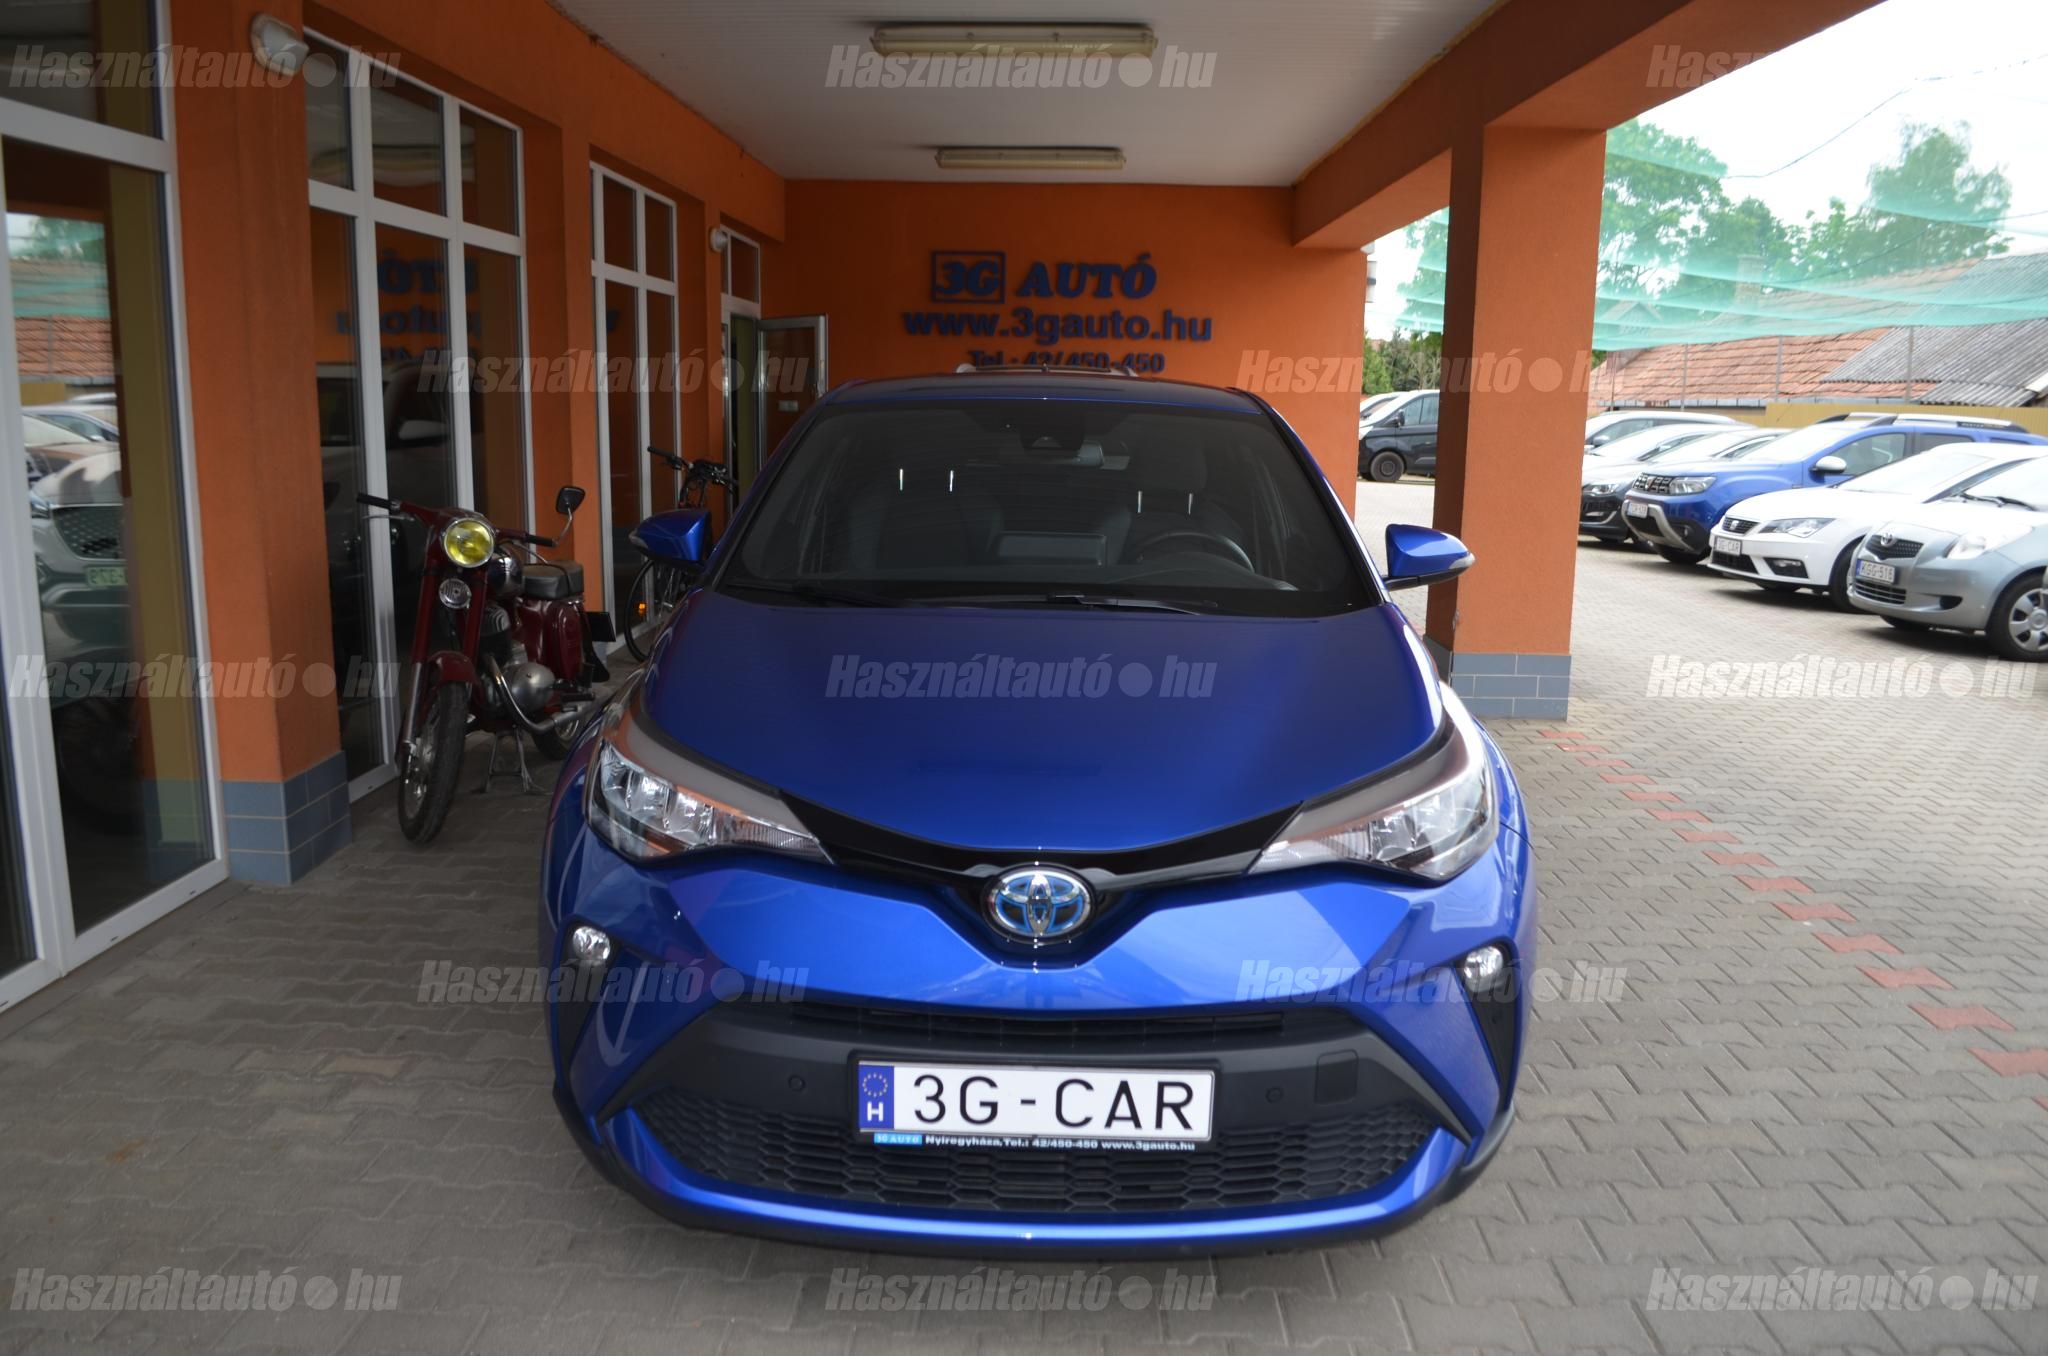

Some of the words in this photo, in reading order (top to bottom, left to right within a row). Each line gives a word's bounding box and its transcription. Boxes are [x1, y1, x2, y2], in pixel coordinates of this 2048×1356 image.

[936, 260, 1000, 295] 3G
[1018, 252, 1157, 298] AUTÓ
[903, 306, 1212, 345] www.3gauto.hu
[867, 1102, 884, 1123] H
[1101, 1140, 1196, 1151] www.3gauto.hu
